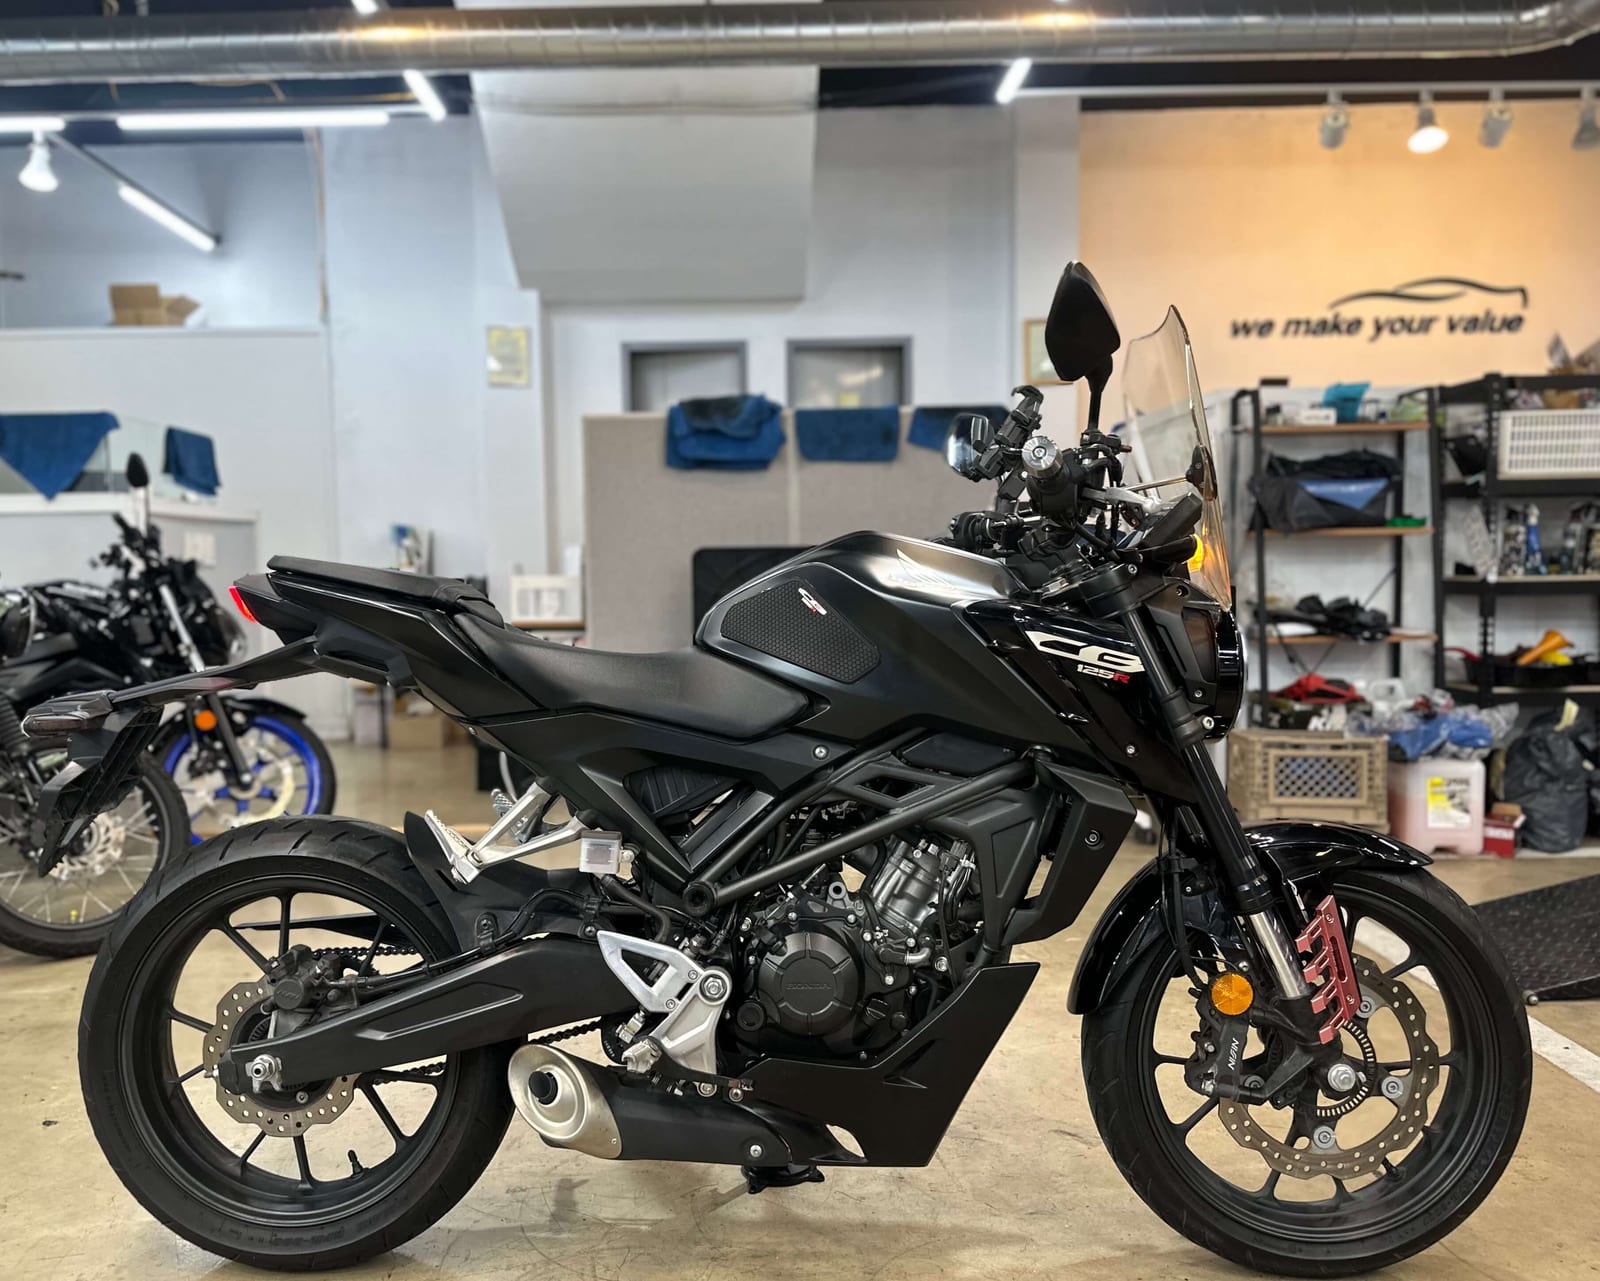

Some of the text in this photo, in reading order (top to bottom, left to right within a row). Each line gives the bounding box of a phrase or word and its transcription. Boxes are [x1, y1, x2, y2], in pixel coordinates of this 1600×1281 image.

[1230, 309, 1524, 342] we make your value
[1076, 663, 1131, 684] 125R
